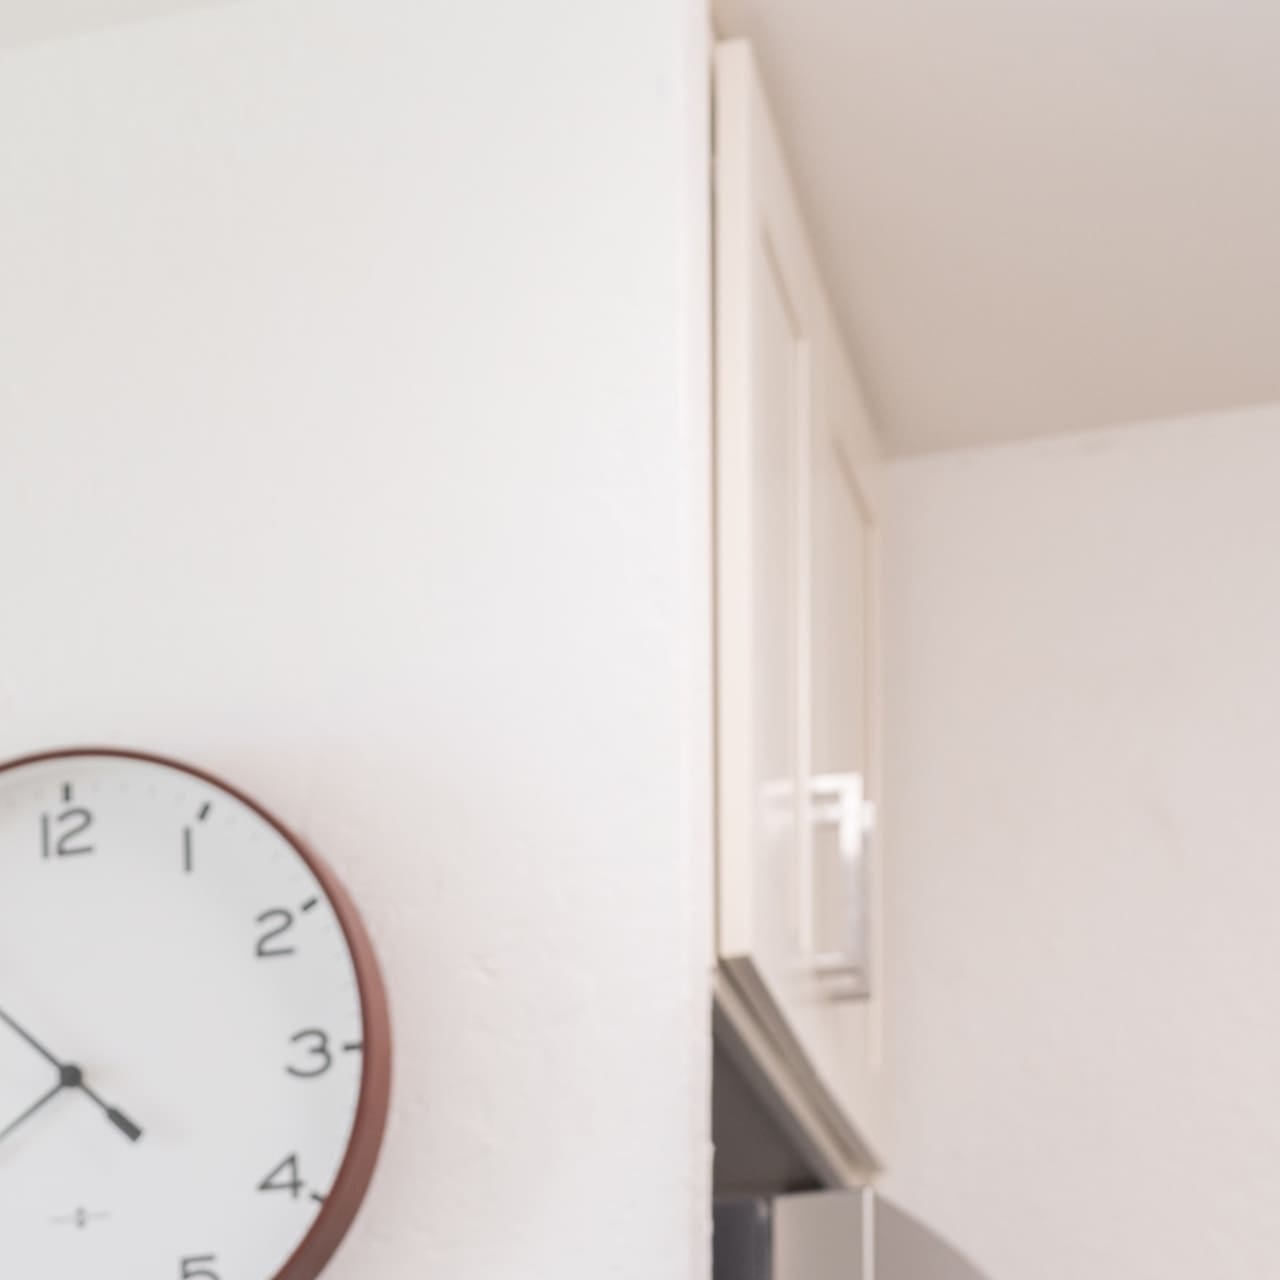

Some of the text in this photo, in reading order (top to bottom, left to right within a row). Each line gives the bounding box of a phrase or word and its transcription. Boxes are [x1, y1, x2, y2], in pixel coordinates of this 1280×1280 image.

[41, 808, 93, 858] 12
[182, 826, 194, 874] 1
[255, 907, 296, 957] 2
[286, 1028, 333, 1079] 3
[257, 1153, 305, 1199] 4
